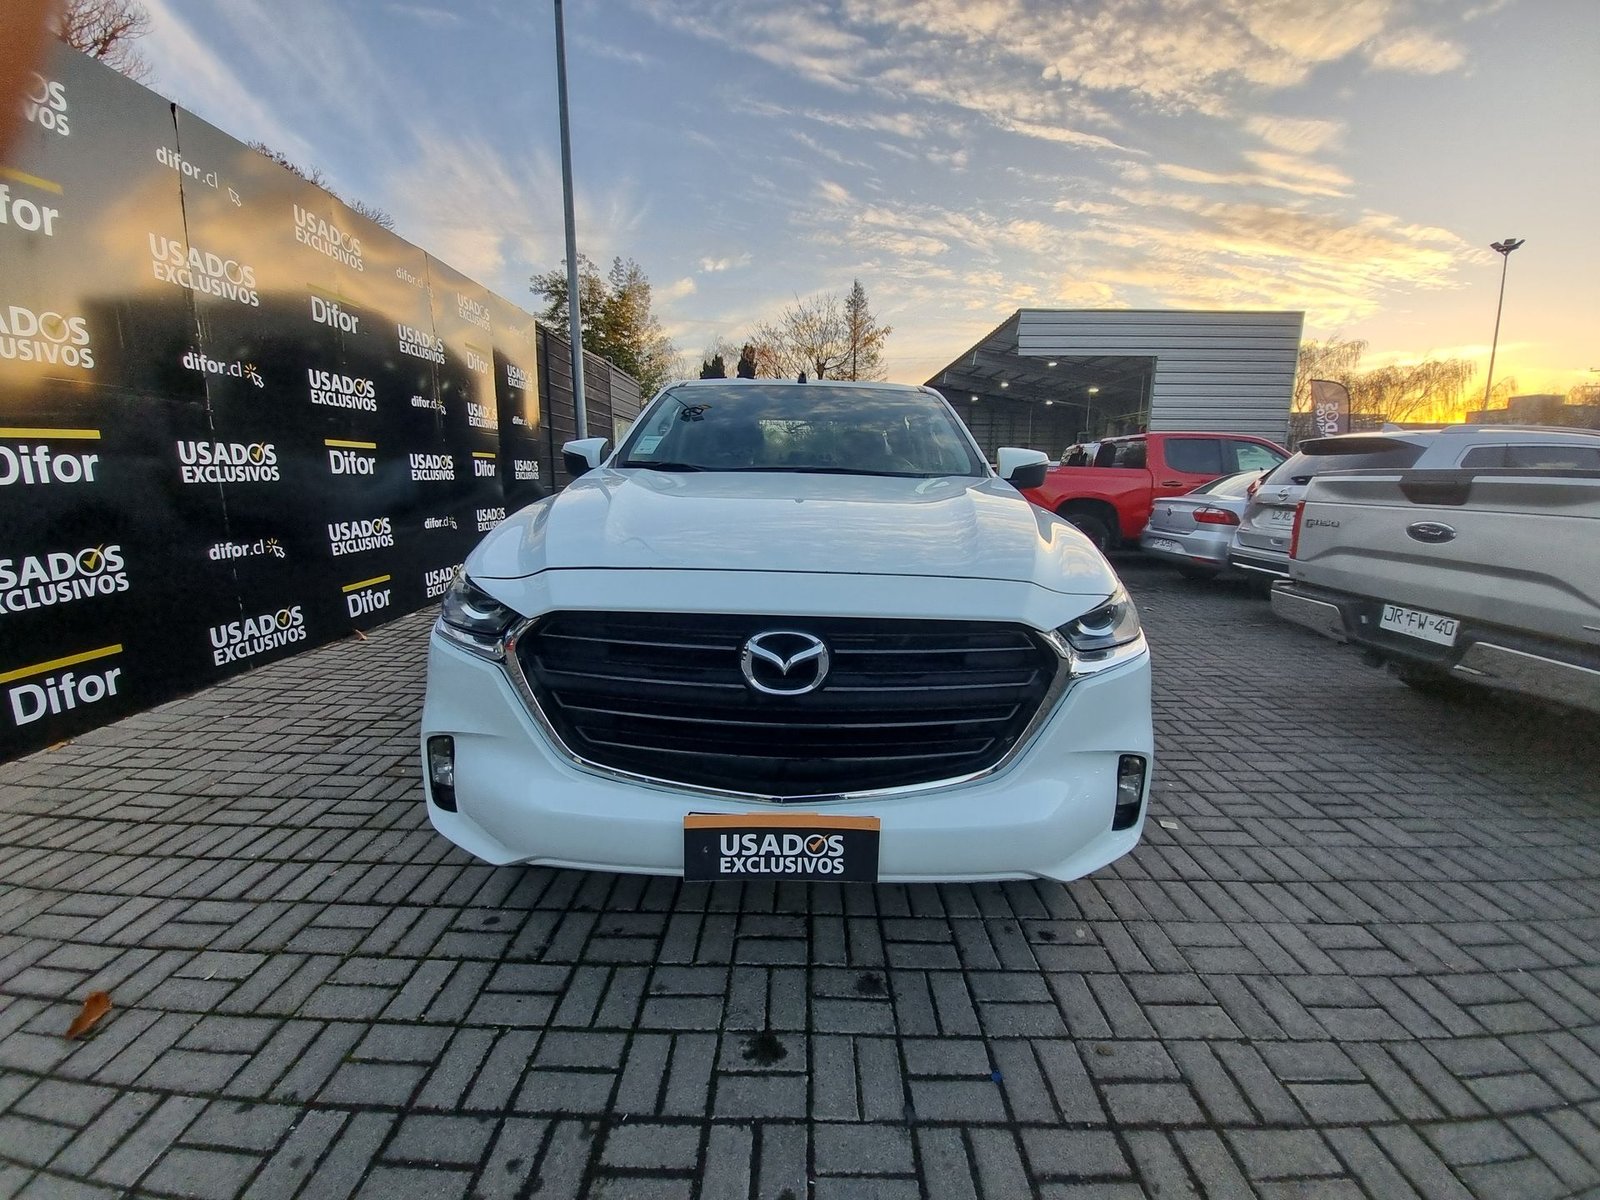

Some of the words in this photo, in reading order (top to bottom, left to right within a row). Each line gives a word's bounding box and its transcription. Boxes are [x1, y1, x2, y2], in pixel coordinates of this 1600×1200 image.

[155, 146, 219, 189] difor.cl
[0, 183, 59, 237] for
[293, 204, 363, 257] USADOS
[148, 232, 256, 289] USADOS
[295, 226, 364, 272] EXCLUSIVOS
[152, 260, 260, 307] EXCLUSIVOS
[310, 295, 360, 334] Difor
[397, 323, 444, 353] USADOS
[0, 335, 95, 369] USIVOS
[182, 351, 243, 379] difor.cl
[399, 340, 446, 365] EXCLUSIVOS
[466, 351, 489, 375] Difor
[308, 367, 376, 398] USADOS
[310, 389, 377, 412] EXCLUSIVOS
[467, 402, 497, 421] USADOS
[177, 440, 278, 466] USADOS
[329, 450, 376, 475] Difor
[409, 453, 454, 470] USADOS
[514, 460, 539, 472] USADOS
[181, 465, 281, 484] EXCLUSIVOS
[411, 469, 455, 481] EXCLUSIVOS
[474, 460, 496, 477] Difor
[424, 516, 449, 529] difor.cl
[476, 507, 506, 522] USADOS
[328, 517, 392, 542] USADOS
[209, 539, 266, 561] difor.cl
[331, 534, 394, 556] EXCLUSIVOS
[0, 545, 125, 590] SADOS
[0, 572, 130, 615] XCLUSIVOS
[347, 588, 391, 618] Difor
[209, 605, 304, 649] USADOS
[213, 626, 307, 667] EXCLUSIVOS
[9, 667, 122, 726] Difor
[720, 834, 845, 858] USADOS
[720, 857, 845, 875] EXCLUSIVOS
